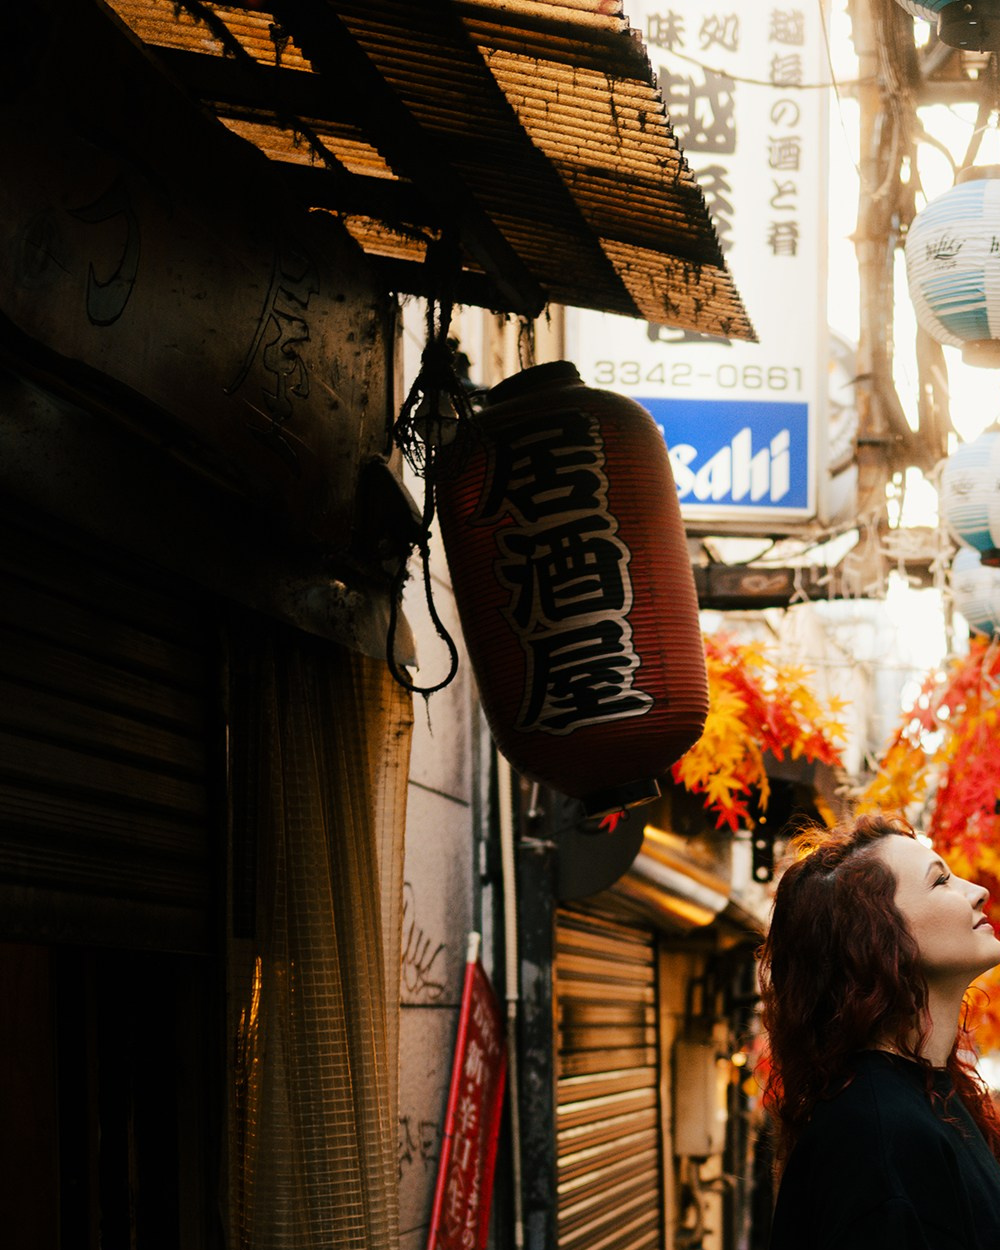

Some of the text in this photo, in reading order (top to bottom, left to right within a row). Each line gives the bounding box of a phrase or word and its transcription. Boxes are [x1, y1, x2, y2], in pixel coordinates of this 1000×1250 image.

[595, 360, 802, 391] 3342-0661
[661, 425, 790, 503] sahi
[474, 408, 655, 732] 居酒屋
